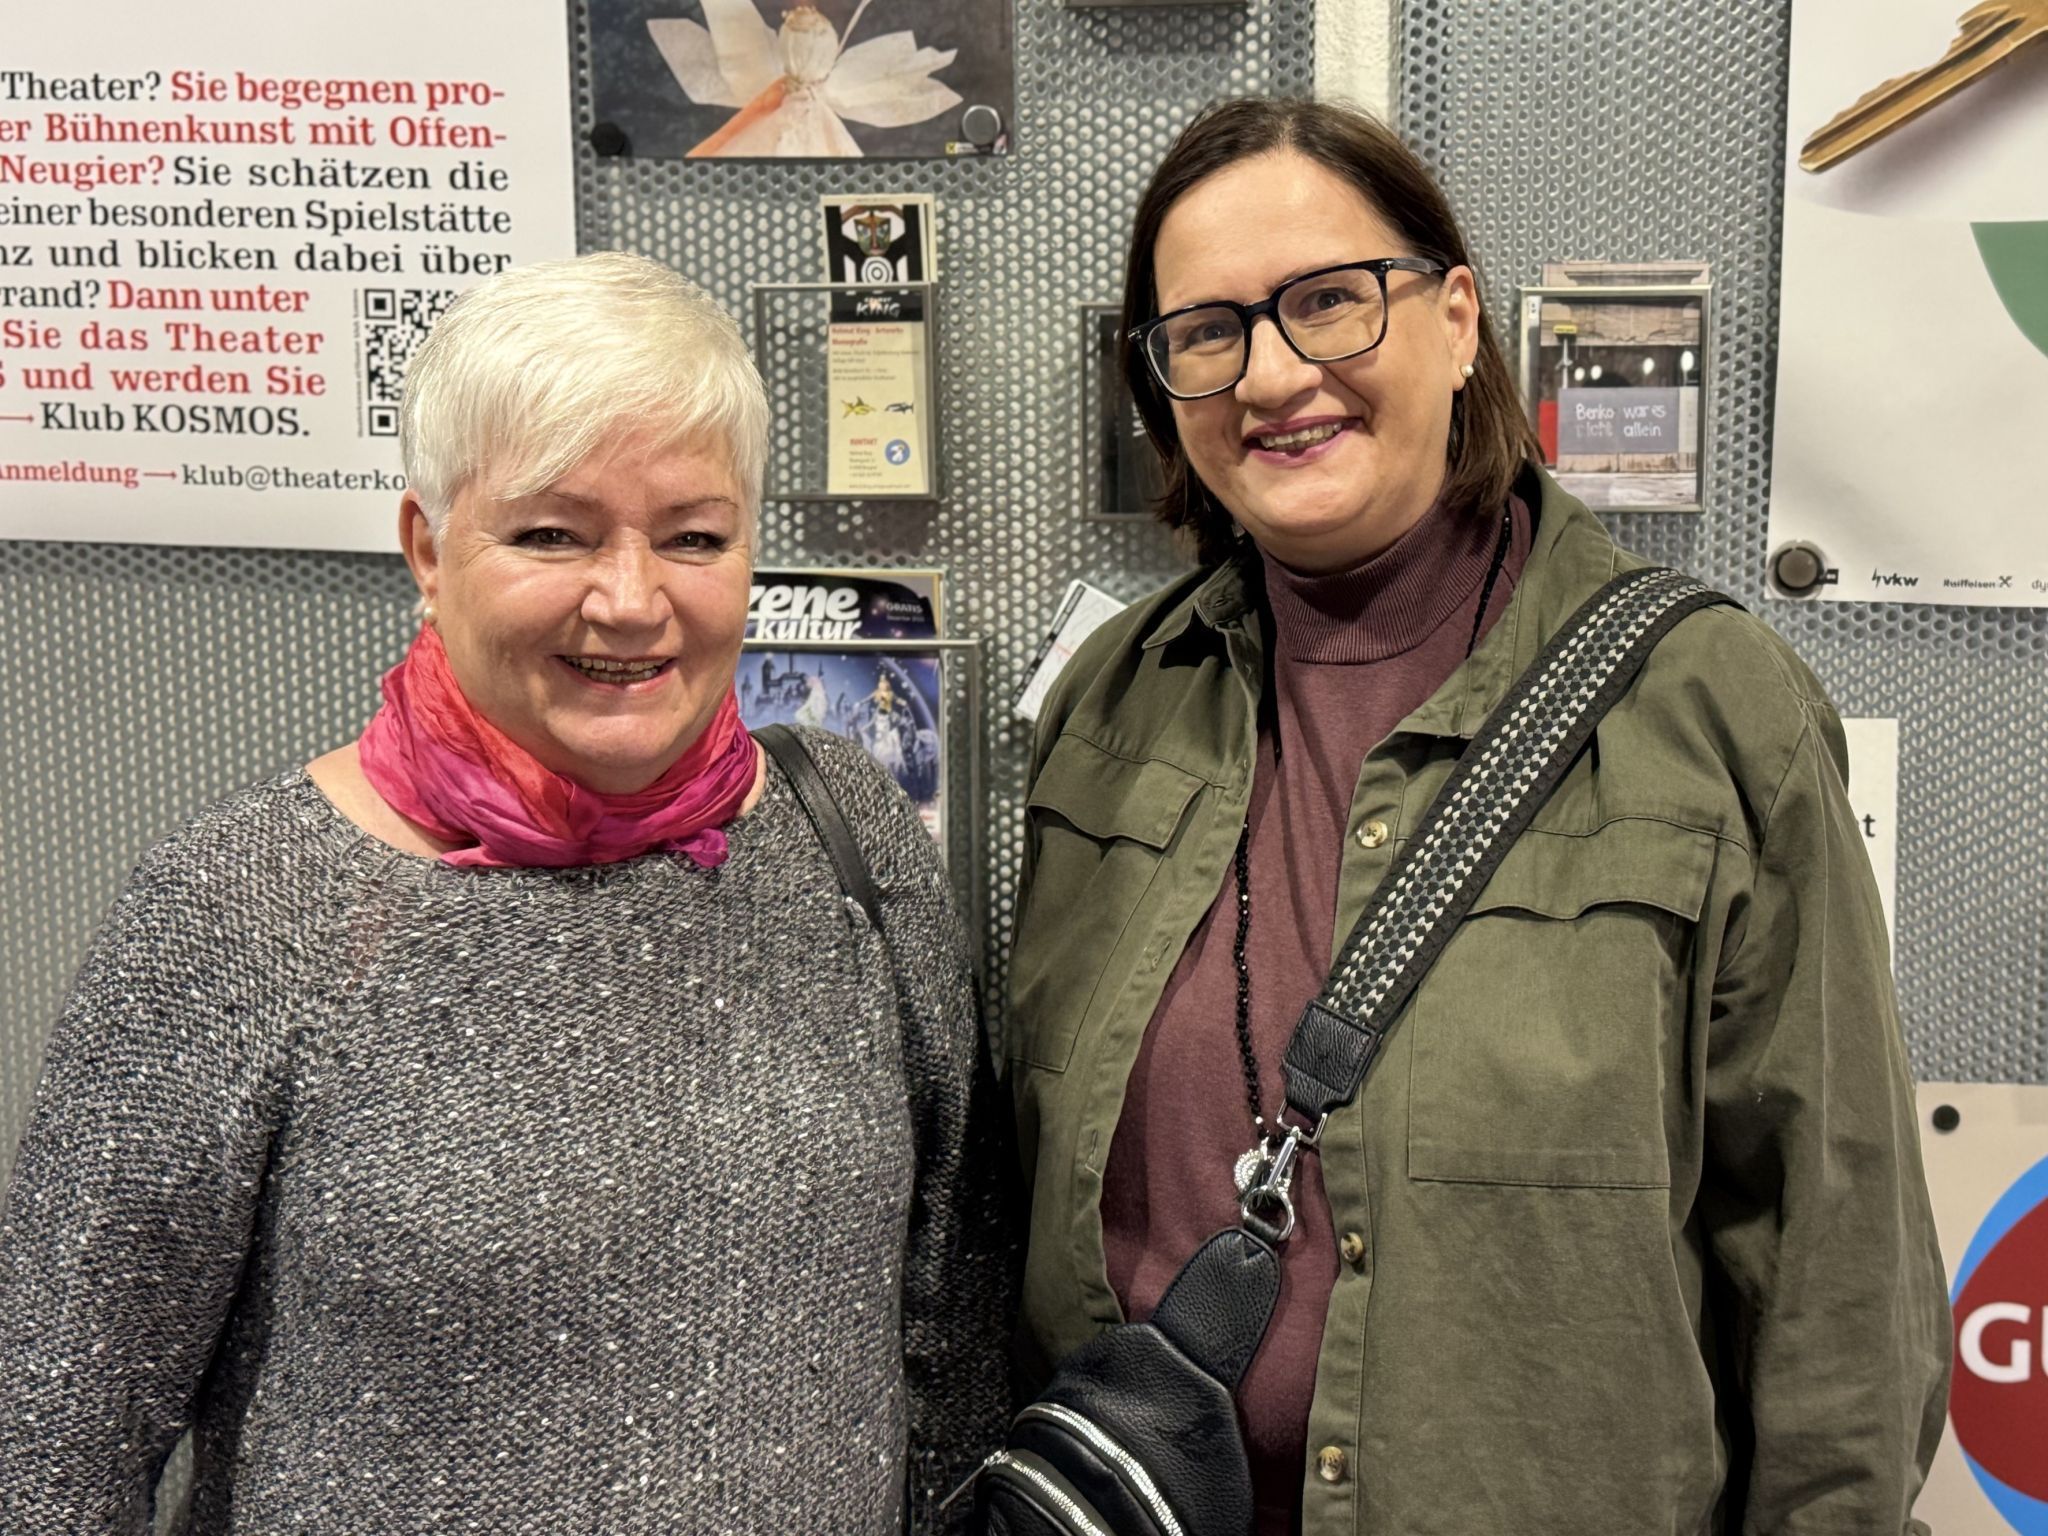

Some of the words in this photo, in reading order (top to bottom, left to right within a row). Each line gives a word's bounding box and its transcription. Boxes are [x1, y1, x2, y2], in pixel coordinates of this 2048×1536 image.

[0, 71, 161, 101] Theater?
[171, 71, 227, 101] Sie
[236, 72, 416, 110] begegnen
[425, 82, 505, 112] pro-
[45, 113, 295, 146] Bühnenkunst
[309, 116, 376, 146] mit
[389, 116, 507, 148] Offen-
[0, 154, 164, 192] Neugier?
[174, 156, 231, 186] Sie
[249, 158, 431, 190] schätzen
[449, 161, 509, 192] die
[87, 197, 297, 229] besonderen
[305, 200, 511, 237] Spielstätte
[49, 239, 121, 268] und
[136, 239, 278, 270] blicken
[294, 242, 404, 274] dabei
[421, 245, 511, 275] über
[0, 280, 100, 309] rand?
[108, 280, 203, 311] Dann
[210, 284, 309, 313] unter
[3, 319, 62, 349] Sie
[80, 321, 149, 351] das
[165, 322, 324, 355] Theater
[22, 361, 93, 391] und
[110, 364, 251, 394] werden
[266, 365, 326, 396] Sie
[40, 401, 125, 432] Klub
[132, 403, 310, 437] KOSMOS.
[1623, 421, 1662, 437] allein
[1882, 572, 1919, 587] vkw
[1943, 579, 1996, 589] Raiffeisen
[756, 613, 862, 640] kultur
[1959, 1301, 2048, 1383] G
